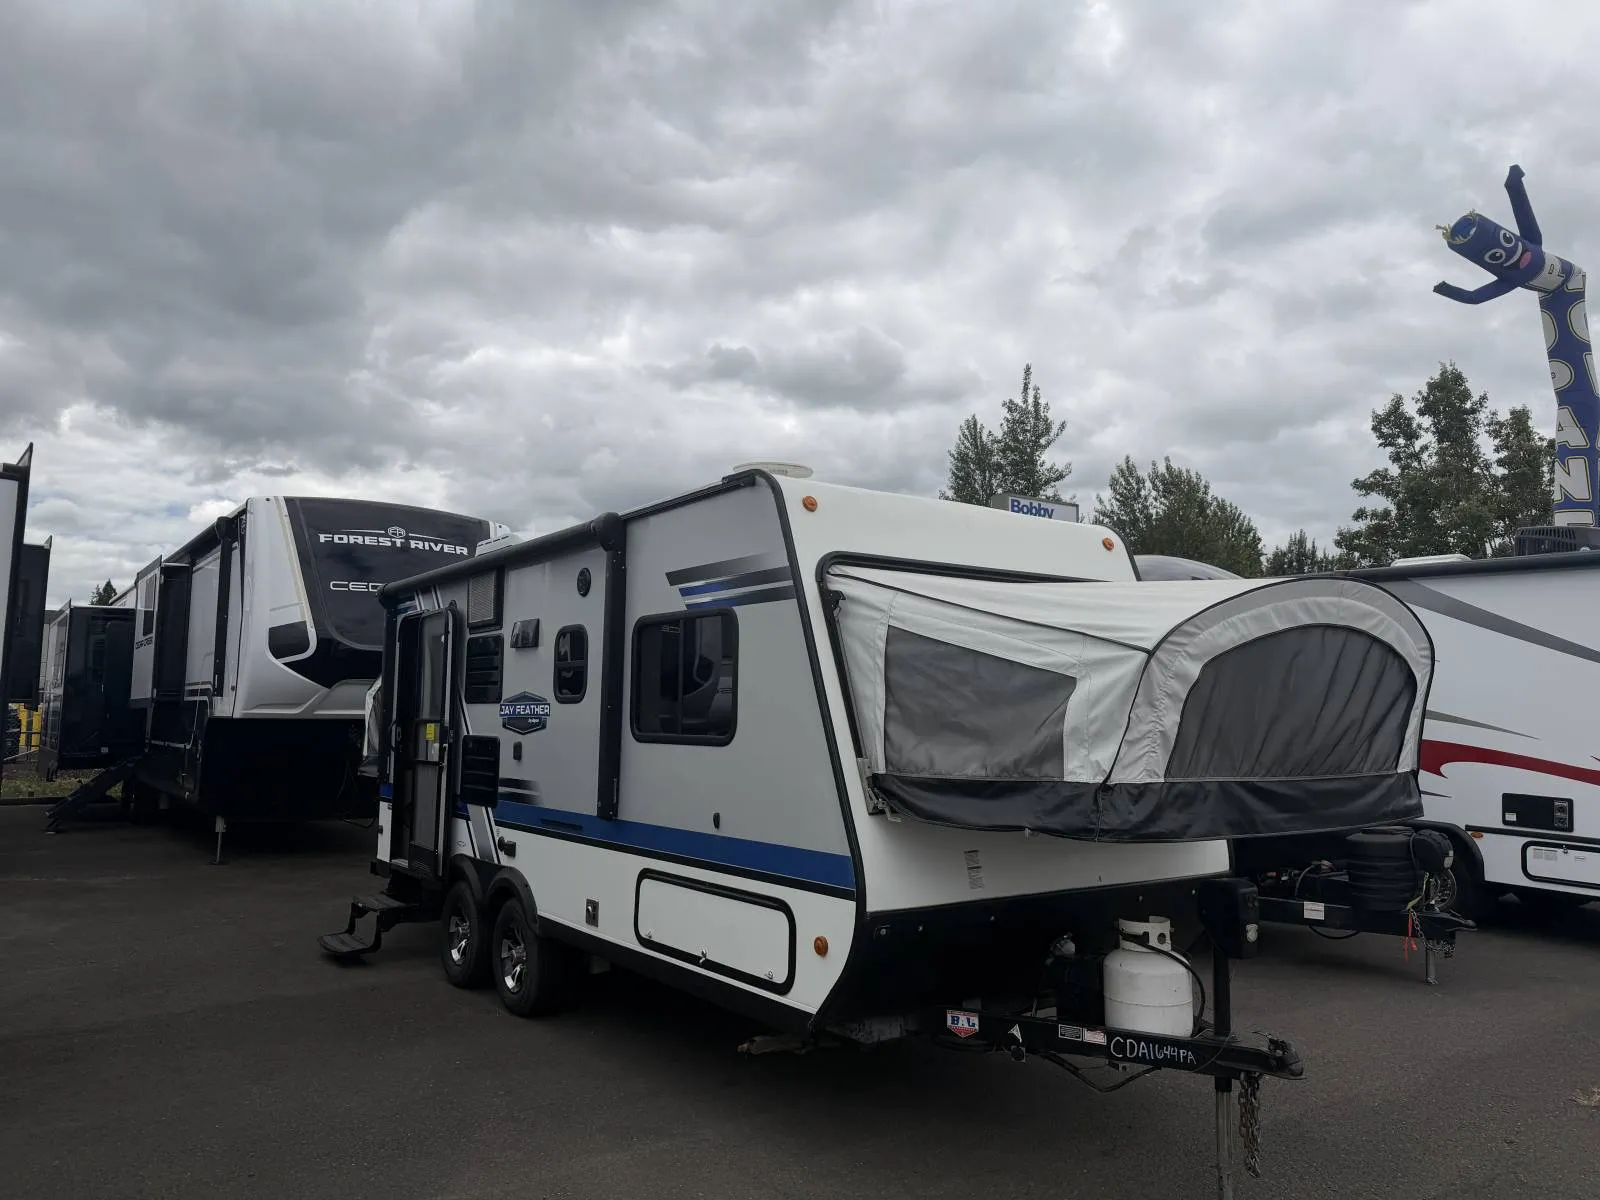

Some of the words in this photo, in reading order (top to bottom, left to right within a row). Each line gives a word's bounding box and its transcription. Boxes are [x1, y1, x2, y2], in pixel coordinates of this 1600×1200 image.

[1011, 498, 1054, 518] Bobby
[318, 533, 405, 548] FOREST
[409, 539, 469, 556] RIVER
[500, 705, 514, 715] JAY
[515, 704, 550, 715] FEATHER
